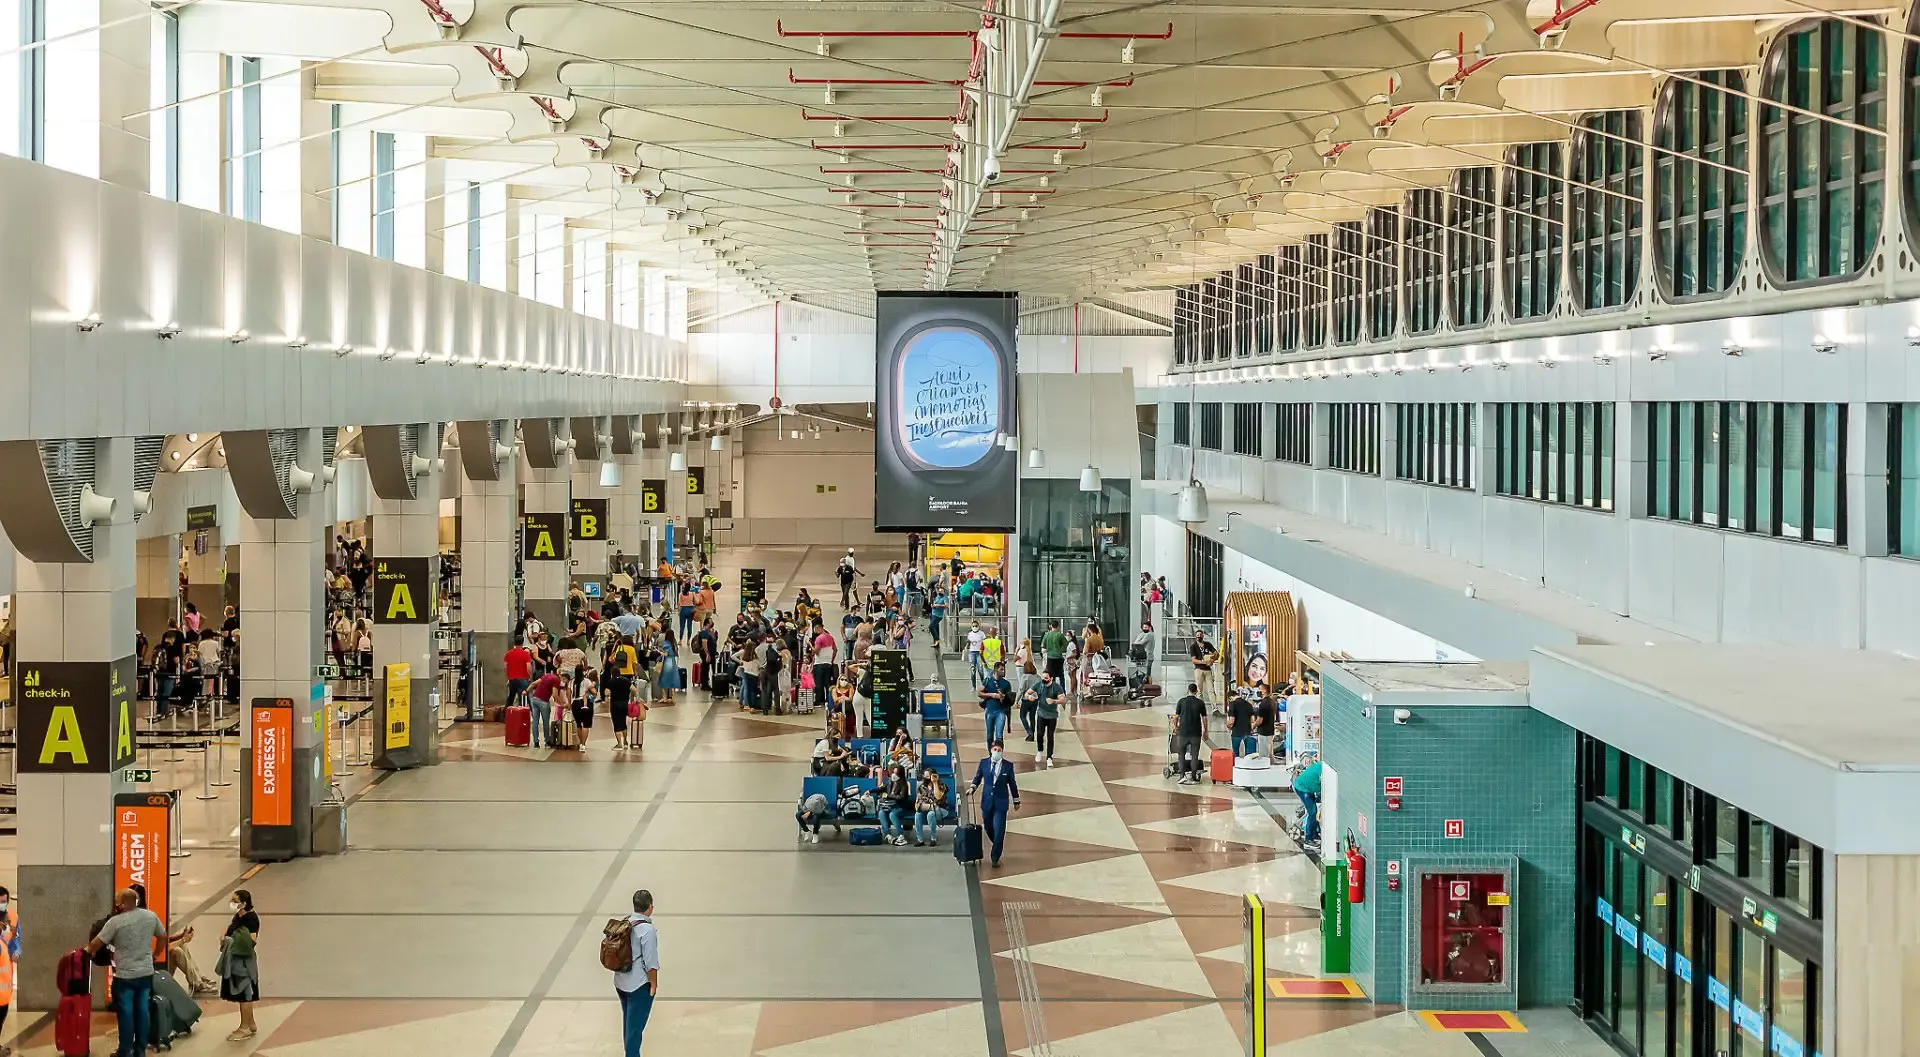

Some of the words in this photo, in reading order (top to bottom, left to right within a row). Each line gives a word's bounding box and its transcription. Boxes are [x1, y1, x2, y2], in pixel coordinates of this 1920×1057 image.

[644, 492, 658, 510] B
[580, 515, 597, 537] B
[533, 532, 556, 556] A
[386, 584, 416, 618] A
[430, 582, 438, 617] A
[25, 688, 71, 698] check-in
[38, 705, 89, 764] A
[116, 700, 132, 761] A
[264, 727, 276, 794] EXPRESSA
[148, 796, 168, 805] GOL
[1449, 822, 1459, 833] H
[130, 833, 144, 885] AGEM
